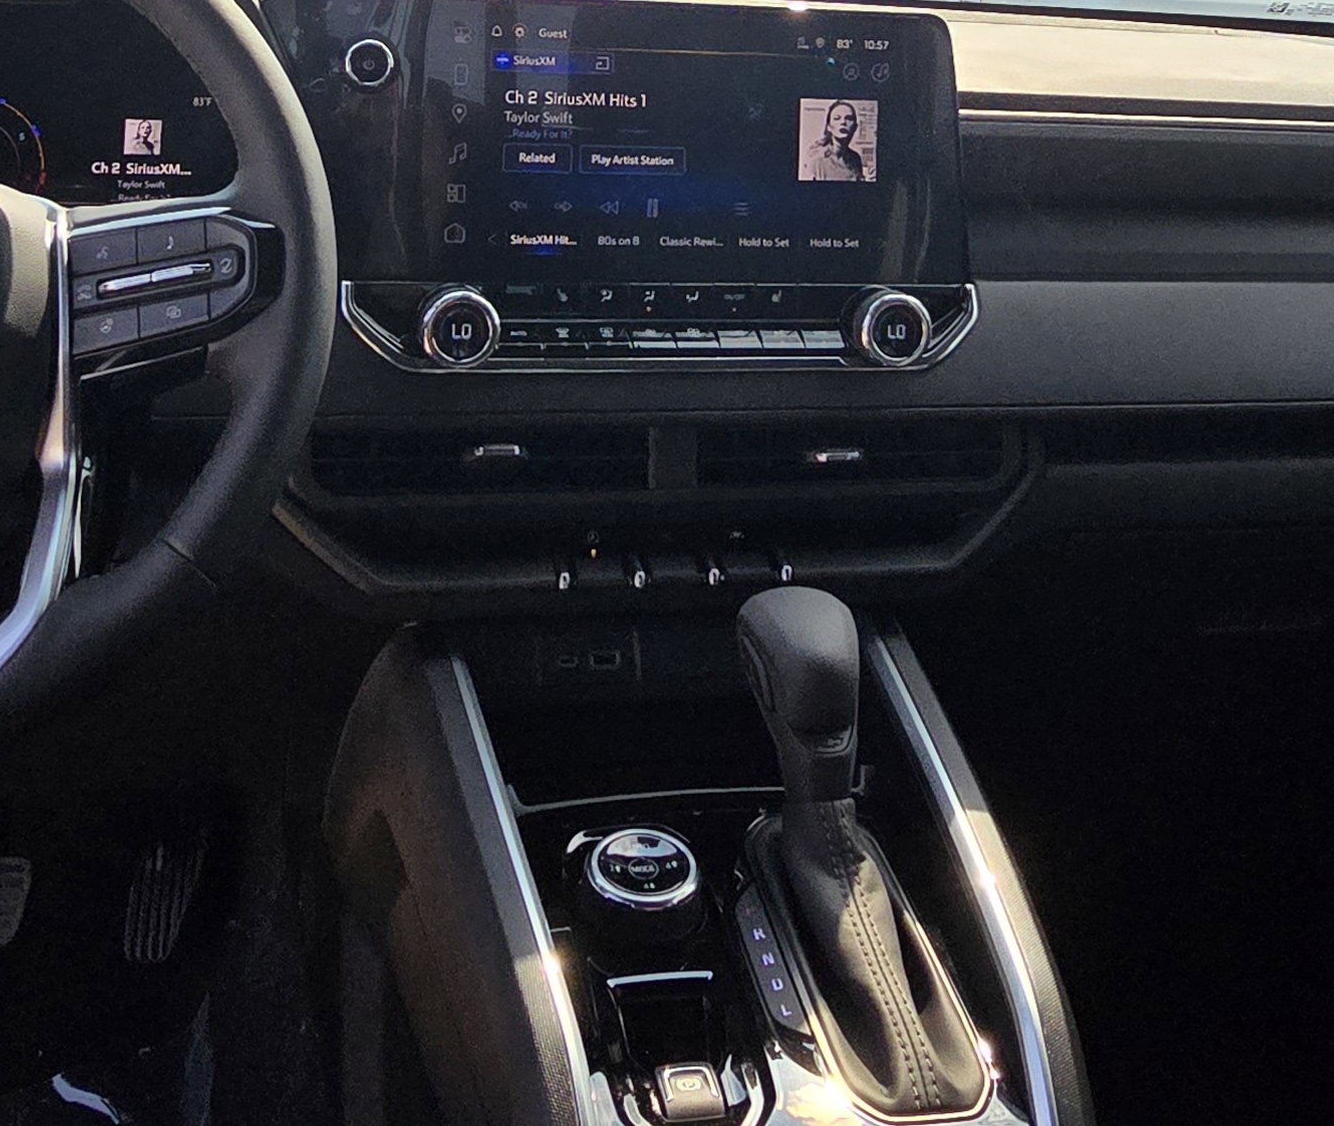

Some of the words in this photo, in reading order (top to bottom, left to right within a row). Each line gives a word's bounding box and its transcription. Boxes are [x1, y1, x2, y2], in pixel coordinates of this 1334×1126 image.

[539, 28, 568, 39] Guest
[864, 40, 889, 50] 10:57
[513, 55, 556, 66] SiriusXM
[504, 90, 524, 105] Ch
[527, 91, 538, 105] 2
[544, 91, 606, 106] SiriusXM
[609, 93, 637, 107] Hits
[640, 94, 647, 107] 1
[504, 110, 539, 125] Taylor
[542, 111, 573, 124] Swift
[519, 152, 556, 164] Related
[591, 154, 611, 166] Play
[613, 154, 639, 165] Artist
[640, 155, 674, 166] Station
[91, 162, 110, 174] Ch
[111, 163, 120, 174] 2
[117, 180, 141, 190] Taylor
[144, 180, 165, 190] Swift
[510, 234, 553, 245] SiriusXM
[598, 236, 616, 245] 80s
[633, 236, 640, 245] 8
[659, 236, 691, 247] Classic
[739, 238, 761, 247] Hold
[762, 239, 773, 247] to
[774, 238, 789, 247] Set
[810, 238, 831, 248] Hold
[833, 239, 842, 248] to
[844, 238, 859, 248] Set
[451, 323, 472, 340] LO
[887, 324, 906, 340] LO
[752, 927, 766, 940] R
[762, 952, 775, 966] N
[771, 977, 784, 991] D
[780, 1004, 792, 1016] L
